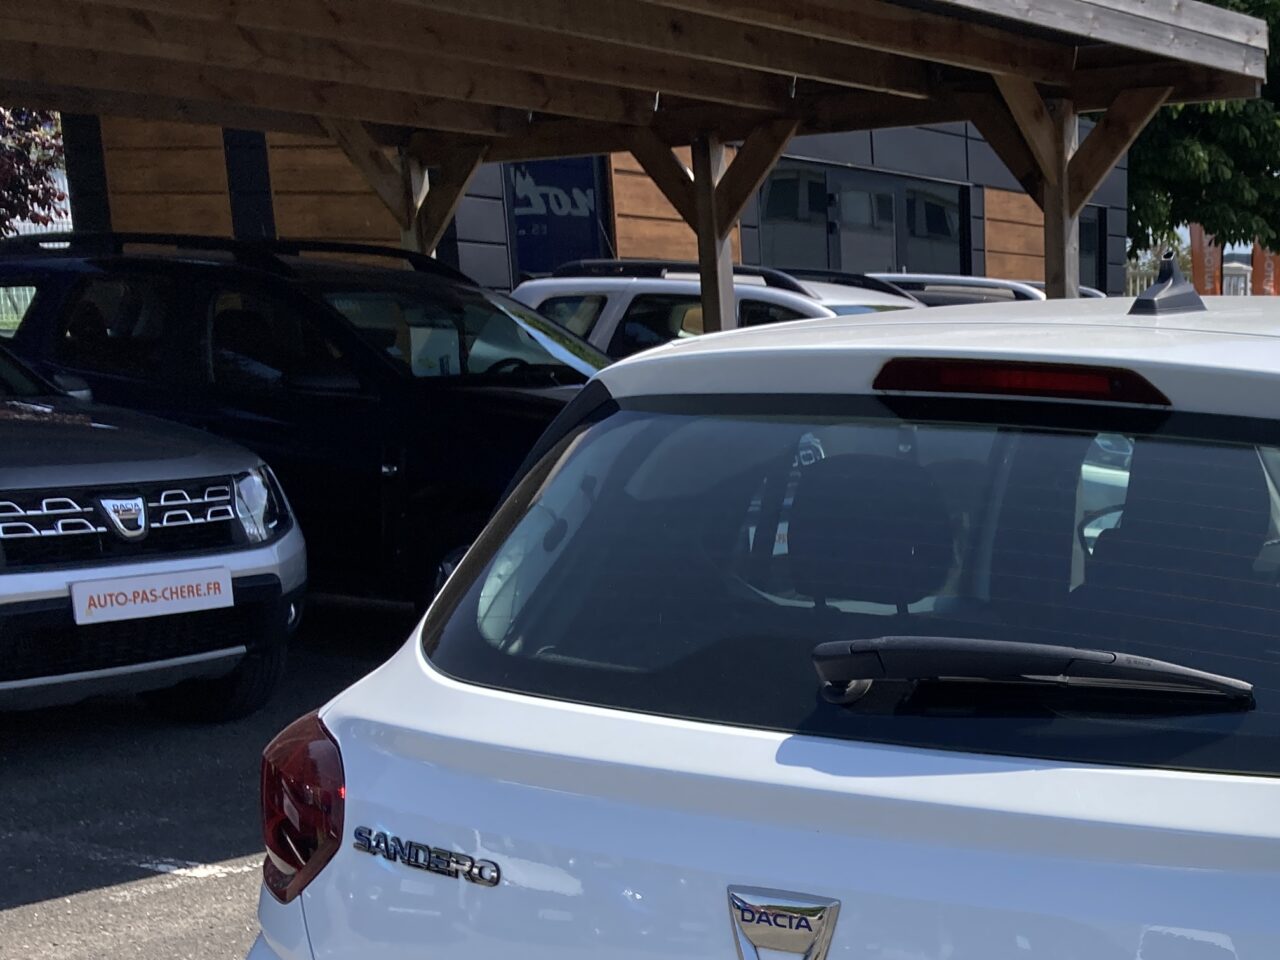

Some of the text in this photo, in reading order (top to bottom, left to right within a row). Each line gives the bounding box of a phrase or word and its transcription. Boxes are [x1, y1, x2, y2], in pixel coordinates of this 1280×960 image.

[87, 581, 222, 610] AUTO-PAS-CHERE.FR
[353, 825, 501, 888] SANDERO
[741, 907, 813, 933] DACIA
